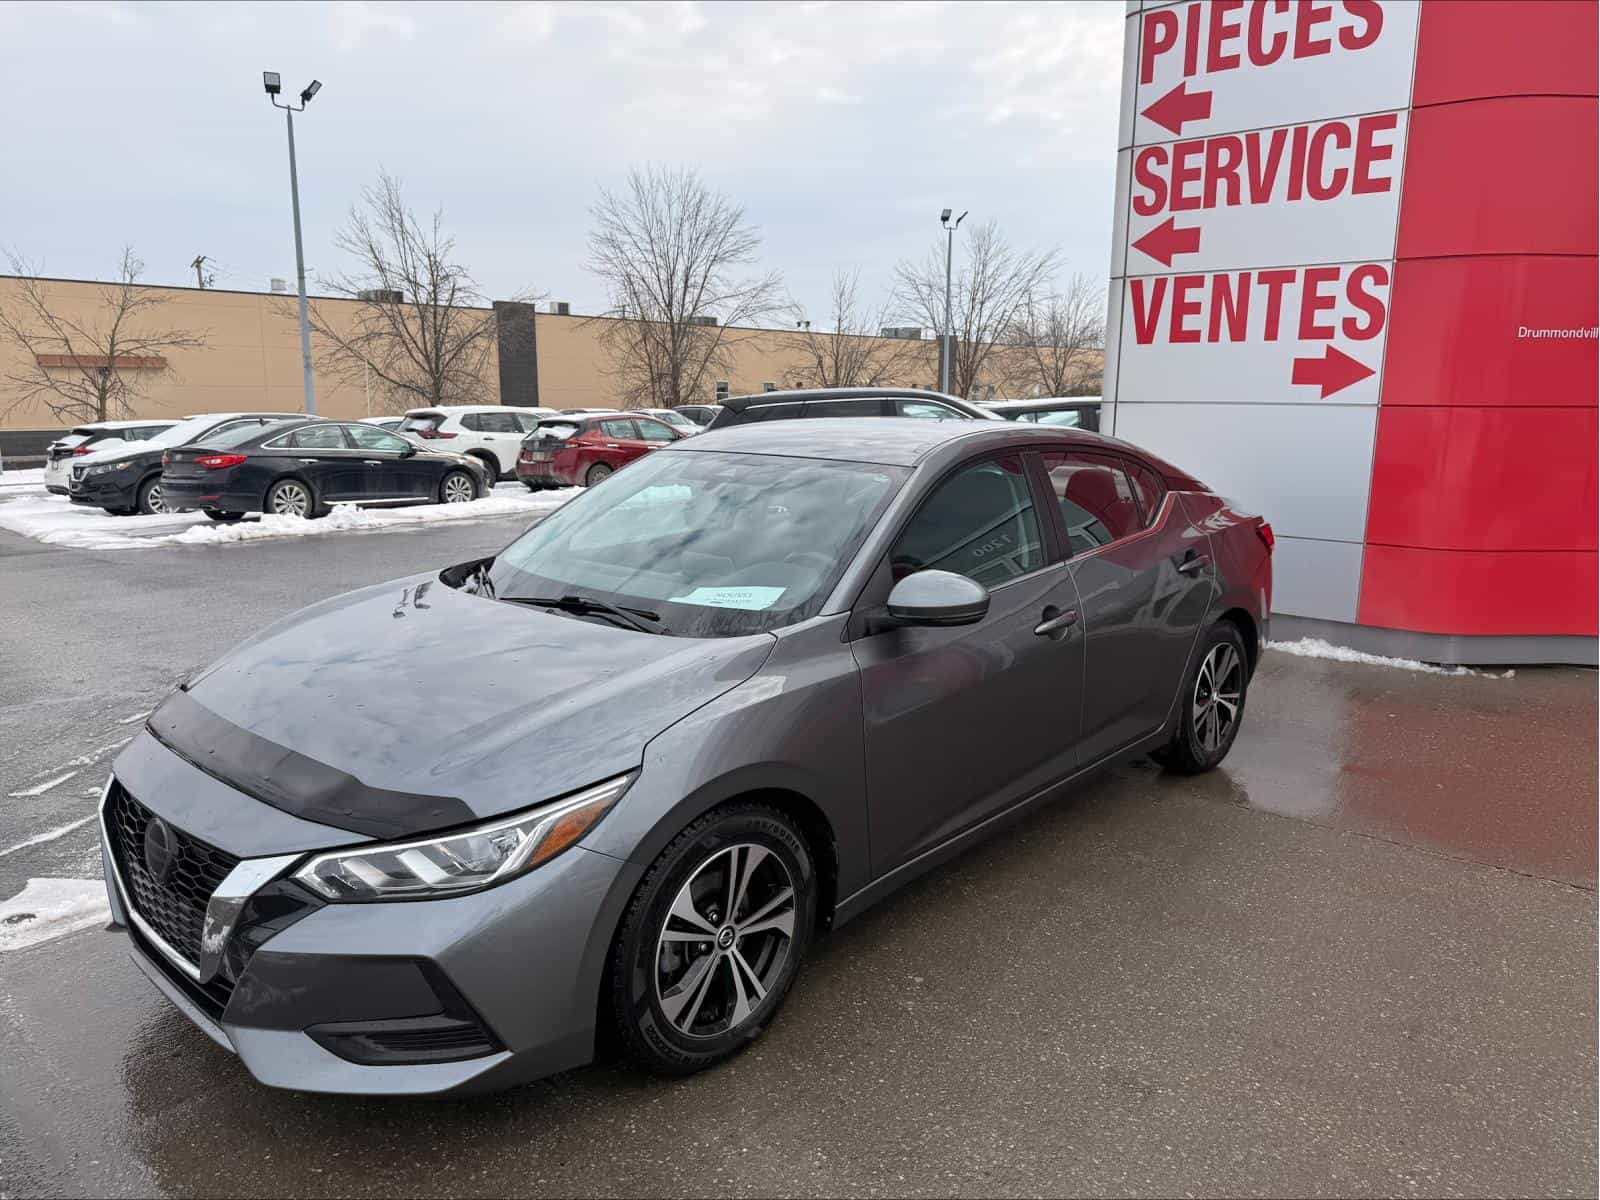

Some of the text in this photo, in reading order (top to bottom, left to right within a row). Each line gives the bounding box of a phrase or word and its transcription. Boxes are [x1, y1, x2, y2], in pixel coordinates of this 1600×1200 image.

[1140, 0, 1384, 84] PIECES
[1132, 113, 1398, 217] SERVICE
[1130, 264, 1390, 345] VENTES
